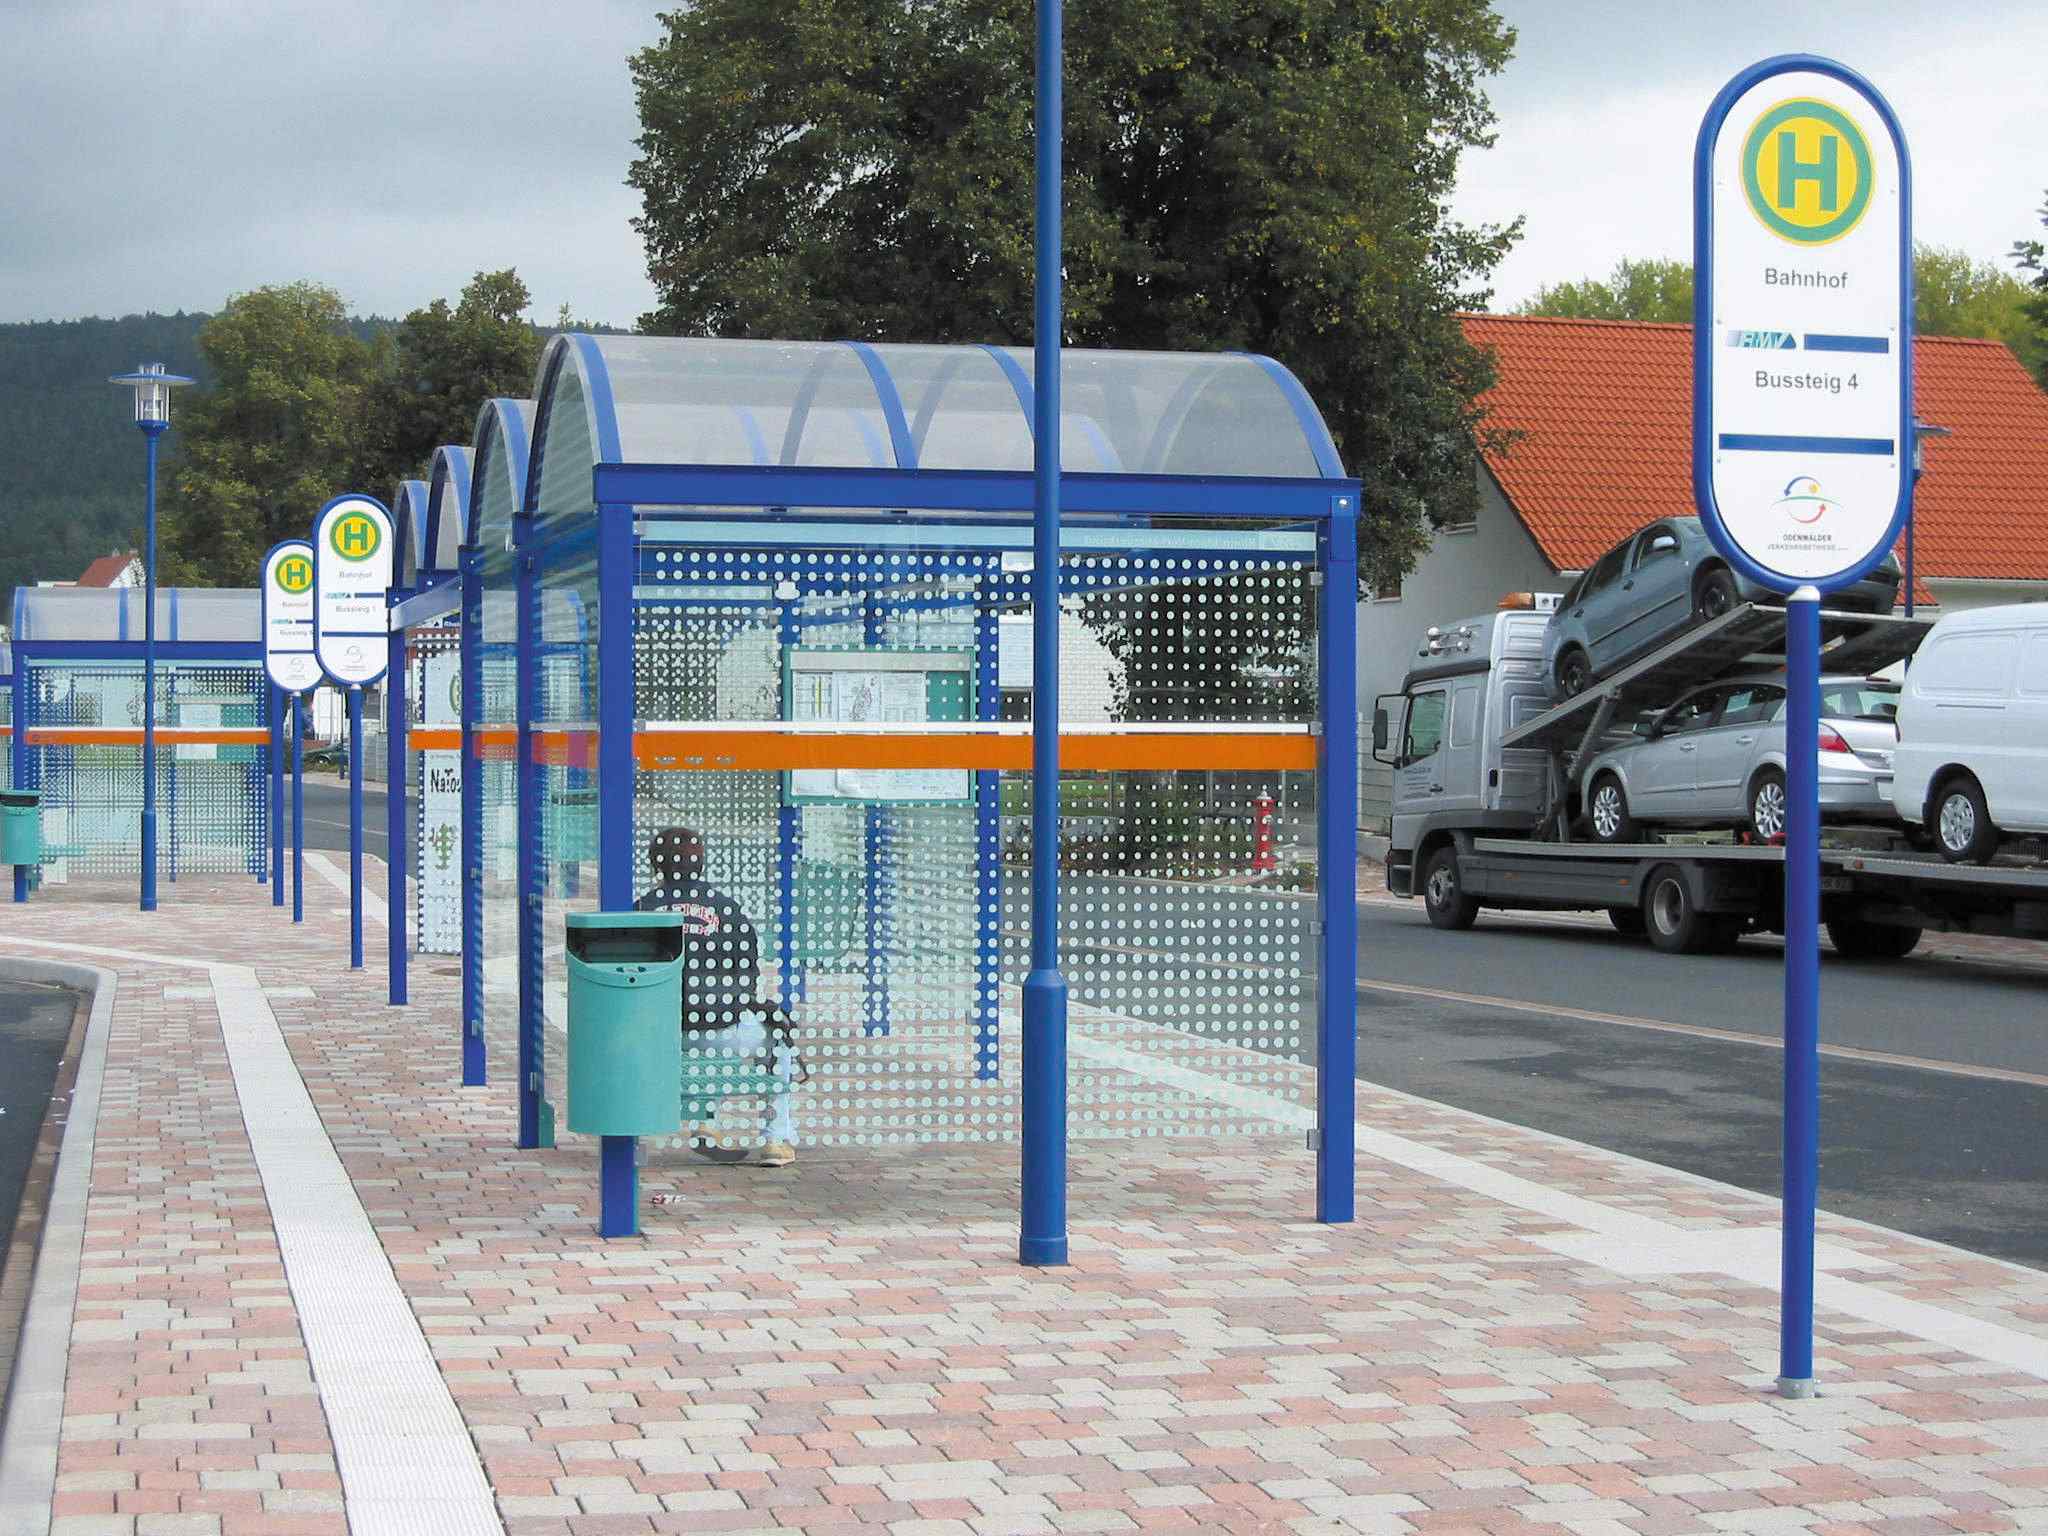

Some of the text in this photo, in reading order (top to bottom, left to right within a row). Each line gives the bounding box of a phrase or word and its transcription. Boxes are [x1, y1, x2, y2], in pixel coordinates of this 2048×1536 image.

[1777, 131, 1839, 211] H
[1764, 267, 1848, 290] Bahnhof
[1755, 370, 1859, 394] Bussteig 4
[343, 523, 368, 551] H
[286, 563, 306, 585] H
